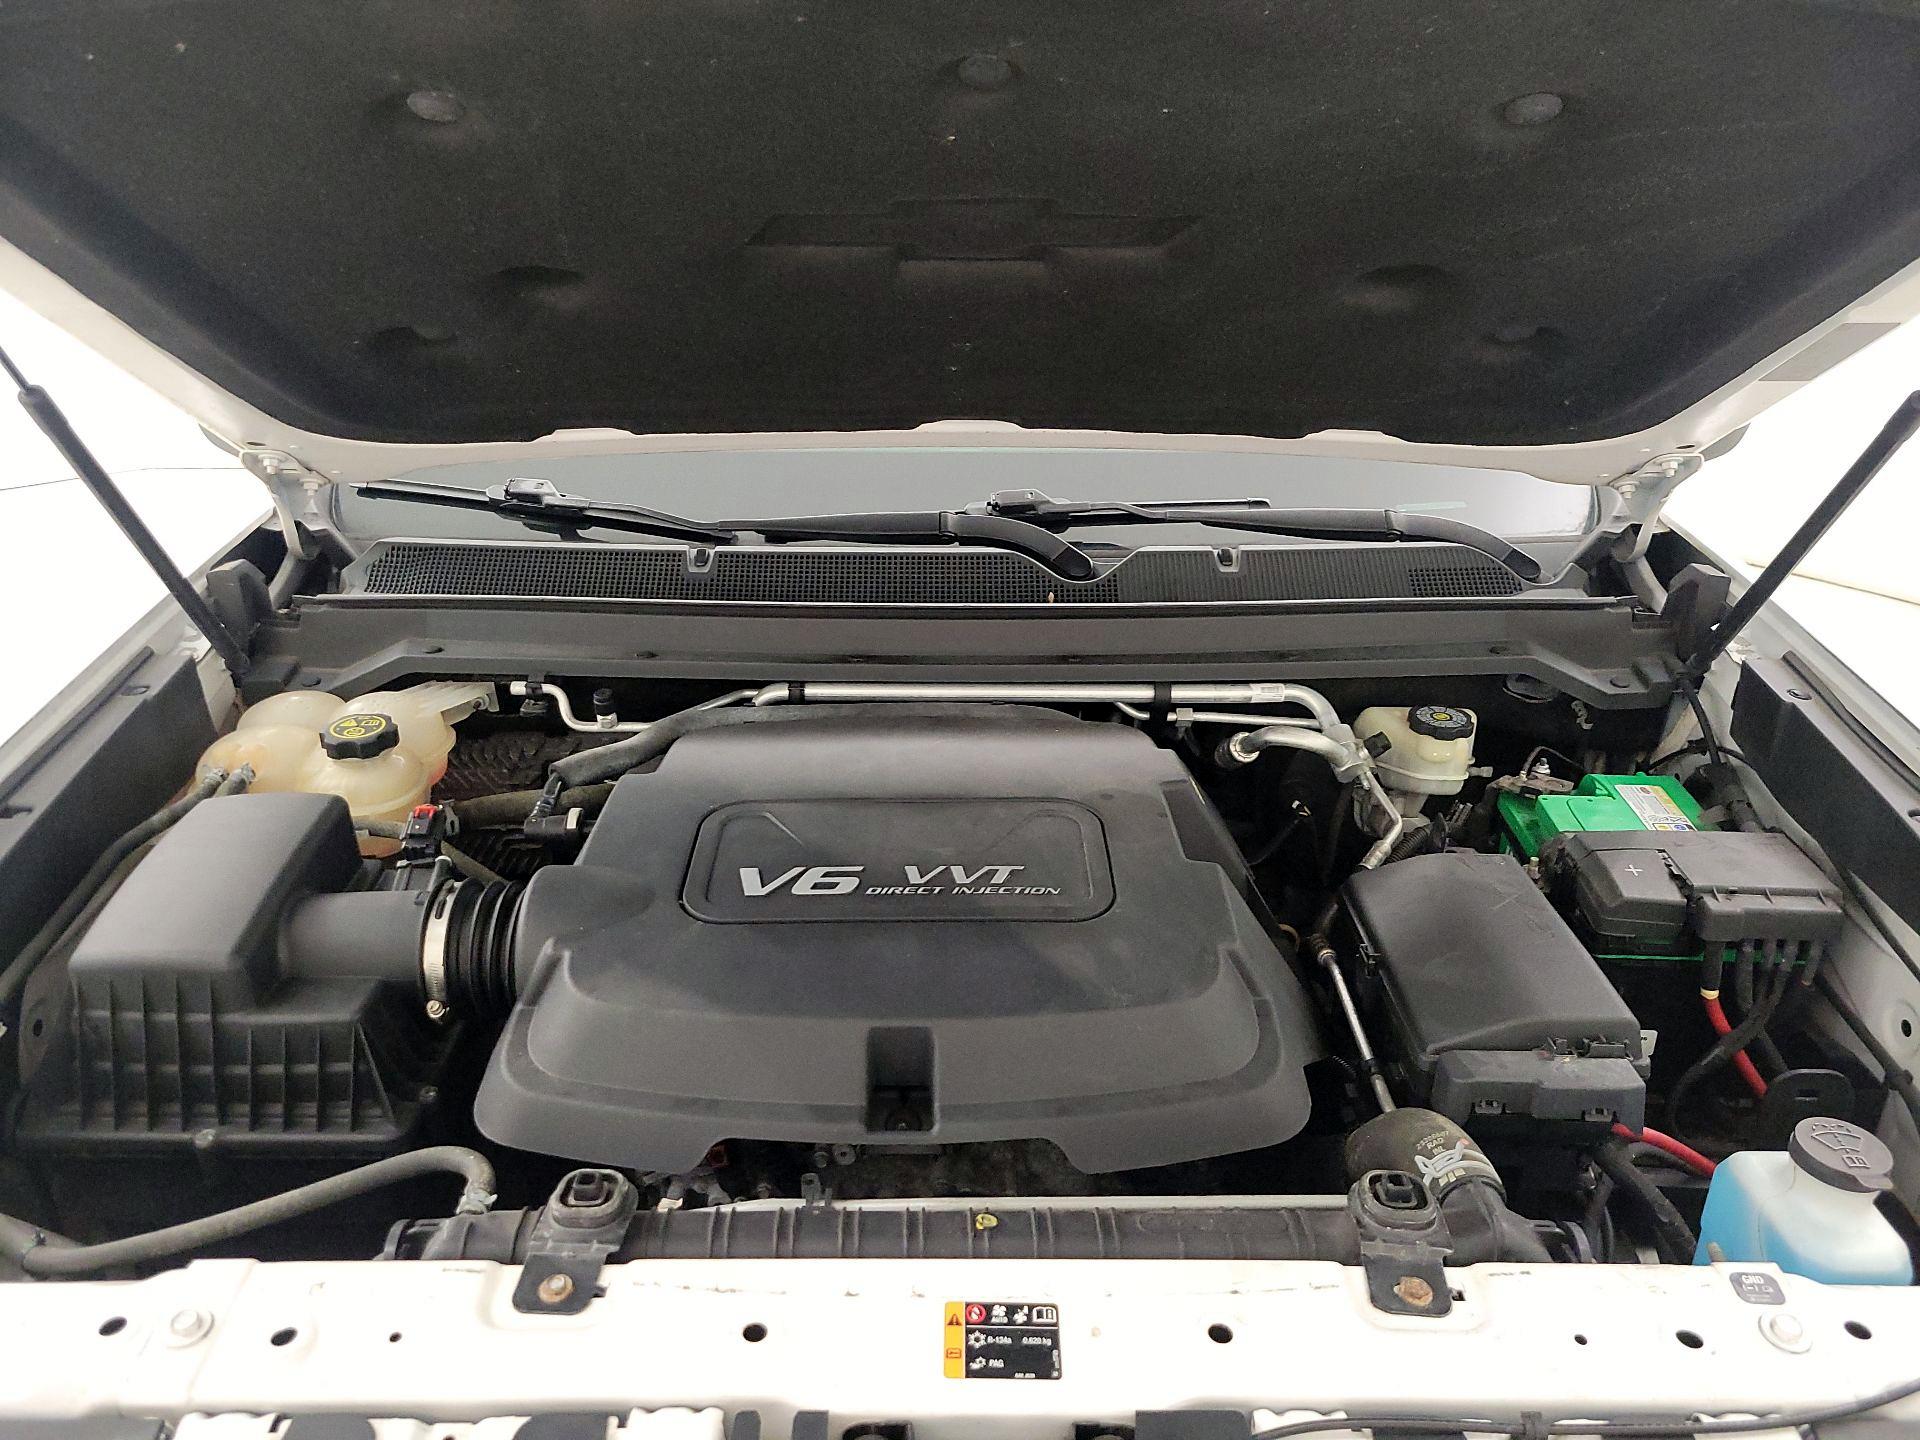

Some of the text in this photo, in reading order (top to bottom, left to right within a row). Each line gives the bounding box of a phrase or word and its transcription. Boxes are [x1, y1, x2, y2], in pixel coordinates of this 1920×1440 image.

[904, 865, 1025, 884] VVT
[739, 865, 865, 896] V6
[865, 886, 1062, 896] DIRECT INJECTION
[1427, 1137, 1444, 1149] RAD
[1741, 1275, 1764, 1284] GND
[1042, 1337, 1052, 1346] kg
[988, 1358, 1005, 1368] PAG
